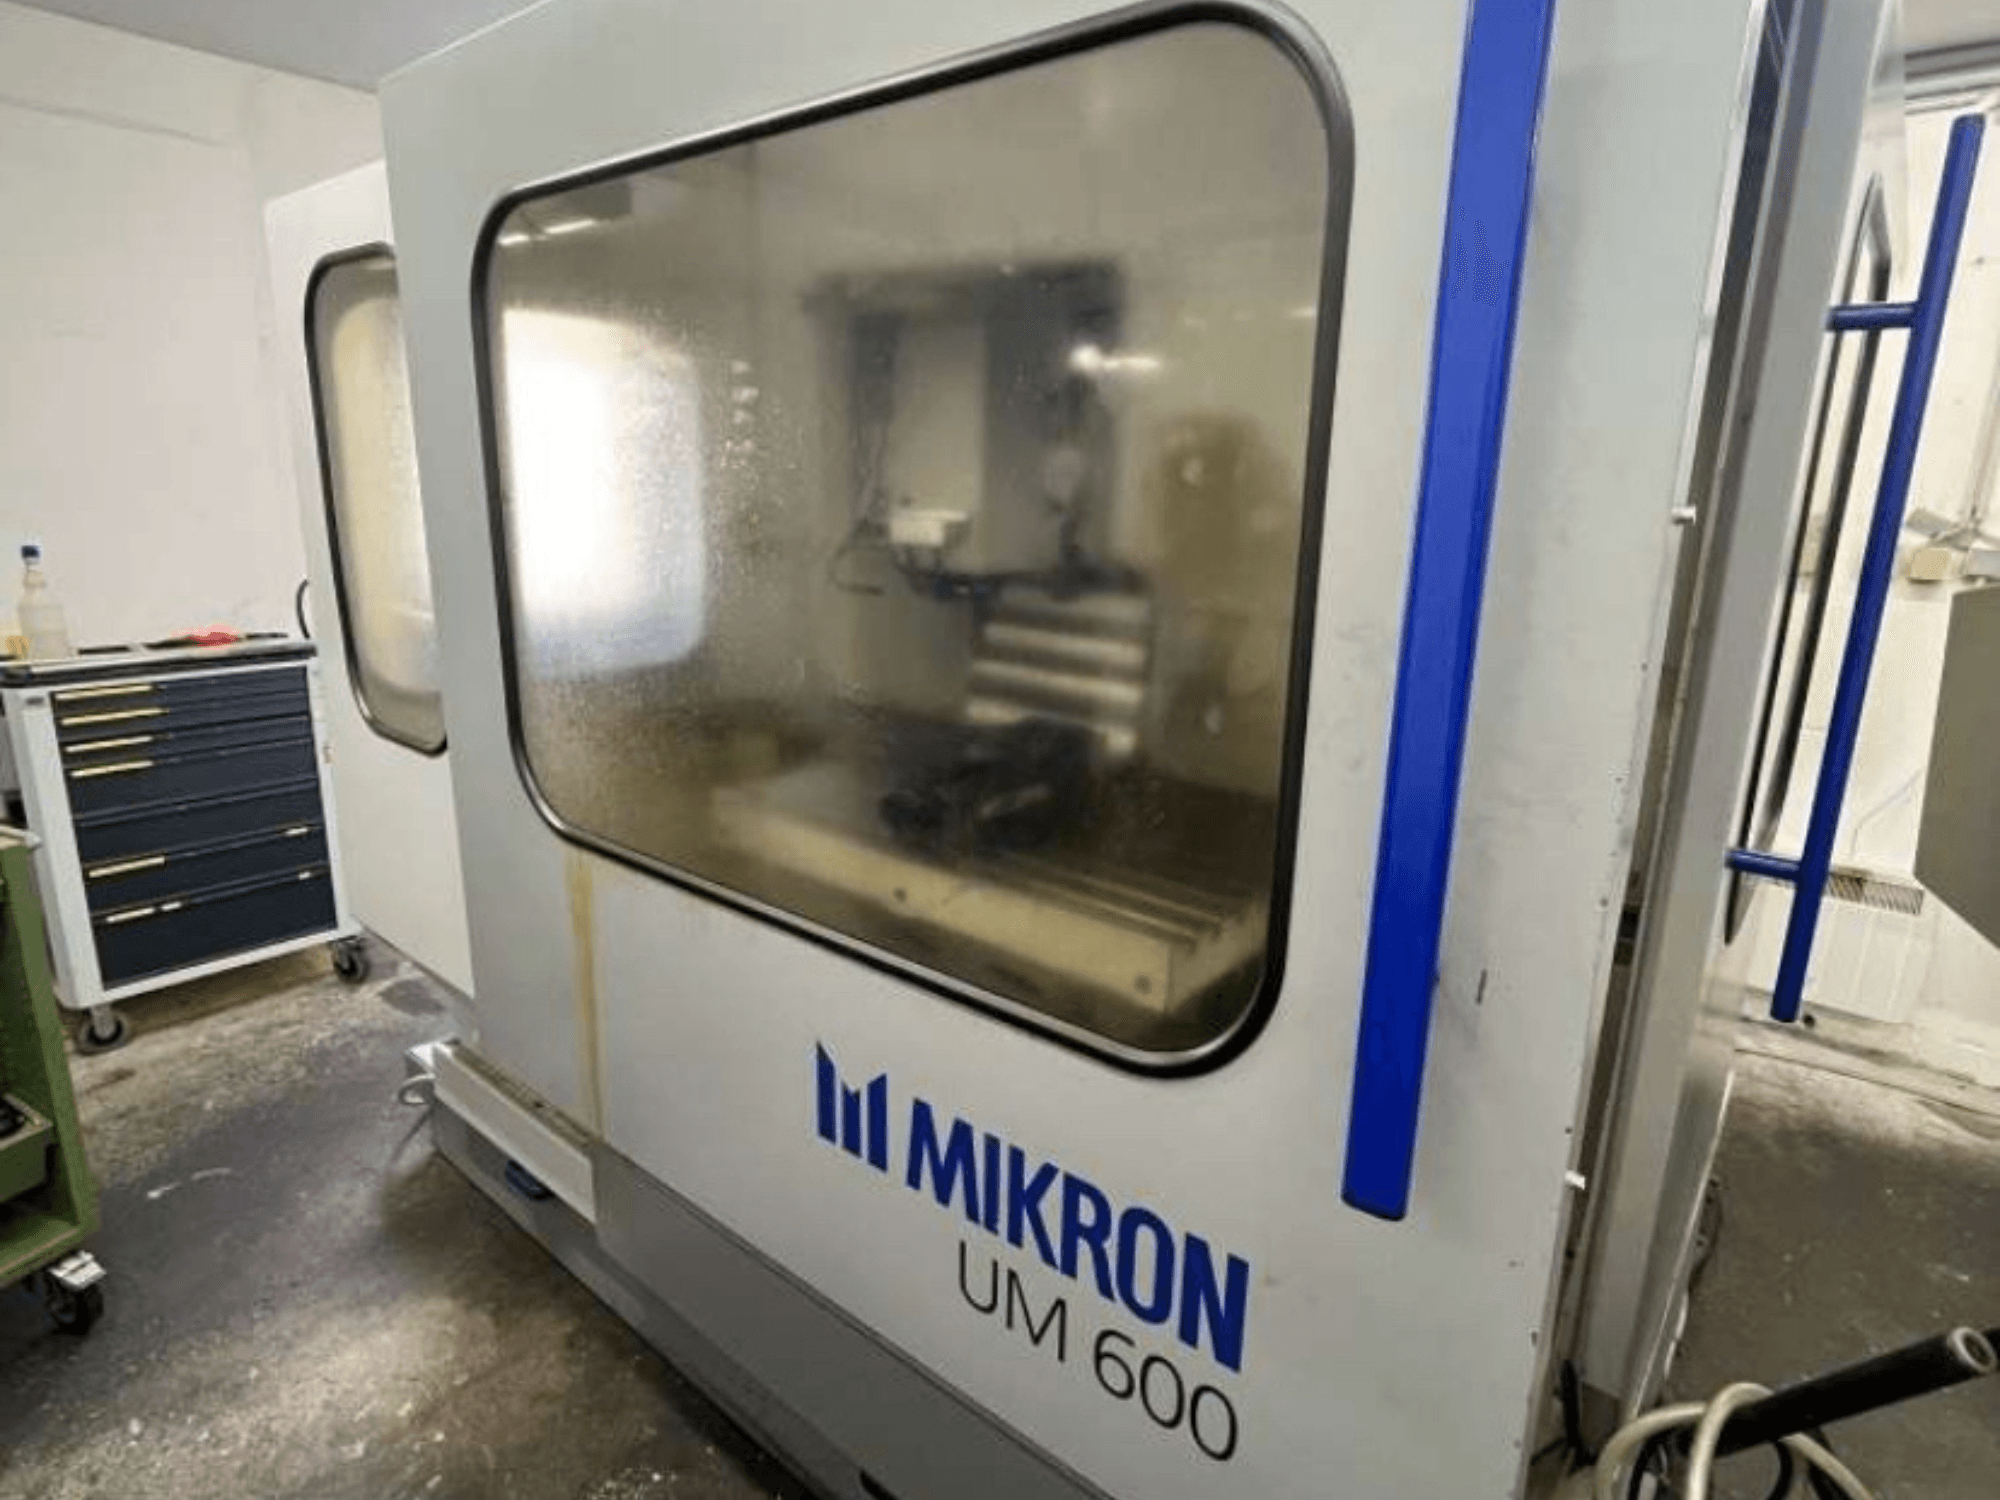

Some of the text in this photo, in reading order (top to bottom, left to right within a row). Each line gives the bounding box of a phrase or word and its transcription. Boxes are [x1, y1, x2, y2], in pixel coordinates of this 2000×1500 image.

[906, 1097, 1249, 1373] MIKRON
[959, 1240, 1238, 1461] UM 600
